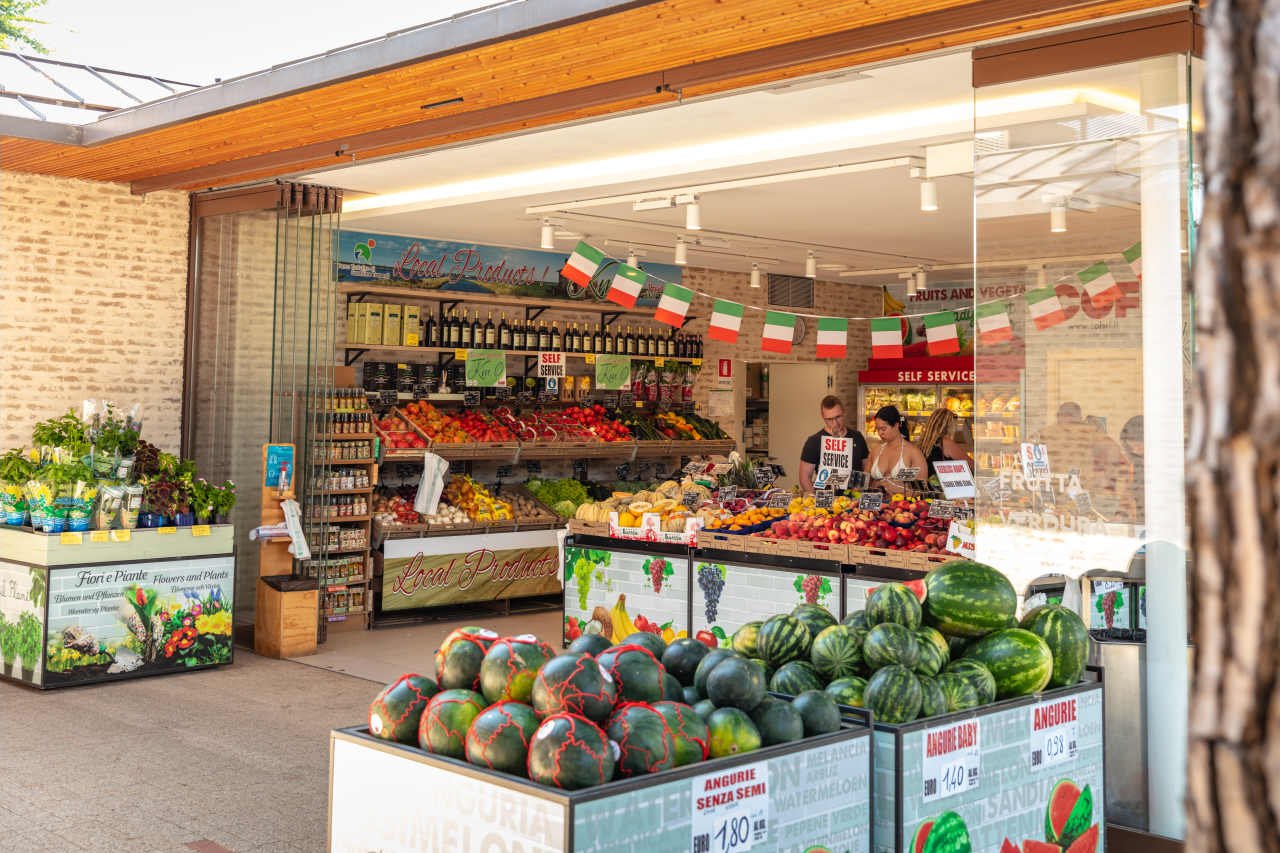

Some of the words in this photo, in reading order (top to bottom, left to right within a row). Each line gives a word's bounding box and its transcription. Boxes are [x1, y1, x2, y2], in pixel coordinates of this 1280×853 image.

[392, 241, 448, 281] Local
[448, 248, 537, 285] Products
[950, 288, 974, 300] AND
[540, 365, 563, 376] SERVICE
[542, 353, 561, 364] SELF
[898, 371, 923, 382] SELF
[927, 370, 976, 382] SERVICE
[825, 439, 847, 452] SELF
[823, 453, 849, 468] SERVICE
[999, 468, 1082, 493] FRUTTA
[75, 570, 106, 588] Fiori
[106, 574, 112, 583] e
[113, 568, 148, 582] Piante
[152, 574, 185, 584] Flowers
[186, 571, 202, 582] and
[203, 570, 229, 580] Plants
[392, 551, 457, 596] Local
[458, 548, 560, 591] Products
[1034, 699, 1077, 731] ANGURIE
[926, 727, 957, 758] ANGURIE
[957, 721, 978, 750] BABY
[704, 768, 756, 792] ANGURIE
[924, 778, 937, 797] EURO
[942, 765, 964, 793] 1,40
[696, 791, 734, 811] SENZA
[736, 782, 766, 800] SEMI
[714, 816, 749, 853] 1,80
